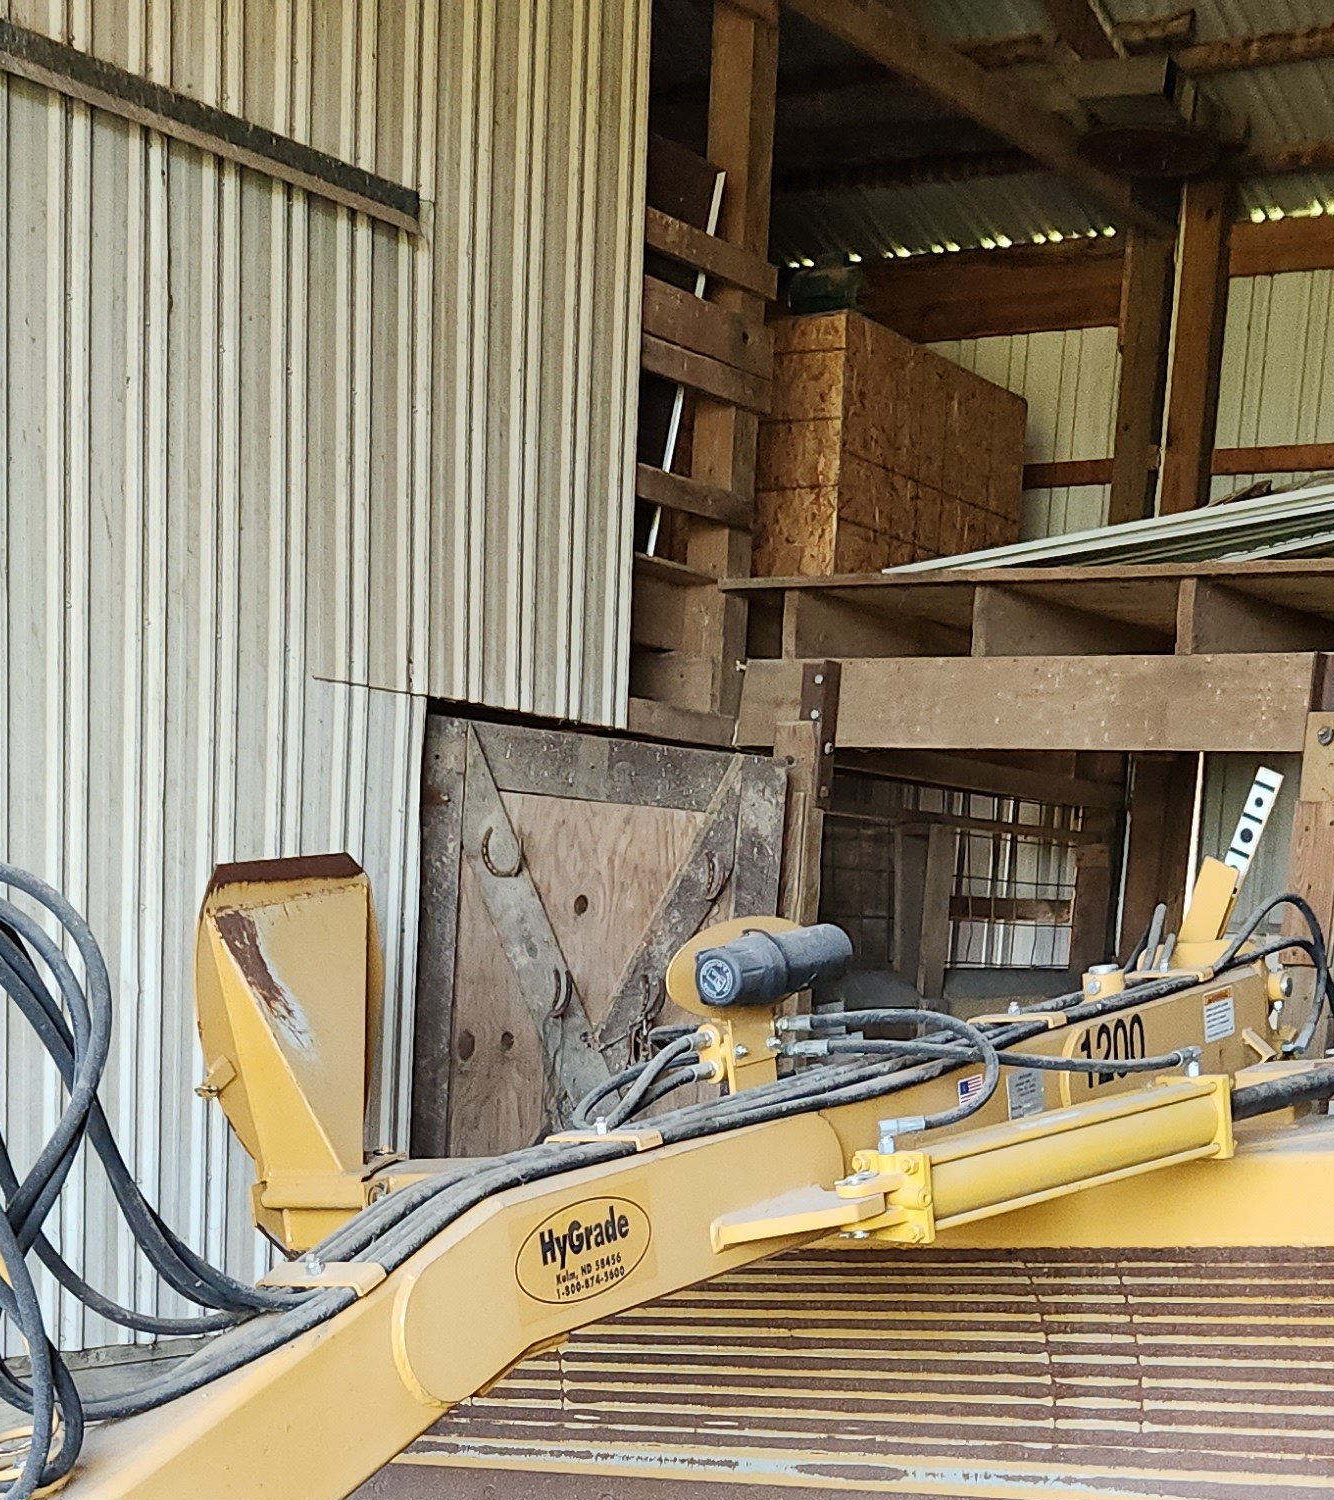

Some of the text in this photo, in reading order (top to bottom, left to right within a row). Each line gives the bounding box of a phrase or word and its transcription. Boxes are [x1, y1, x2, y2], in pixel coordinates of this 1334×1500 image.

[1081, 1013, 1146, 1088] 1200
[539, 1205, 630, 1270] HyGrade
[581, 1263, 593, 1276] ND
[595, 1252, 622, 1271] 58456
